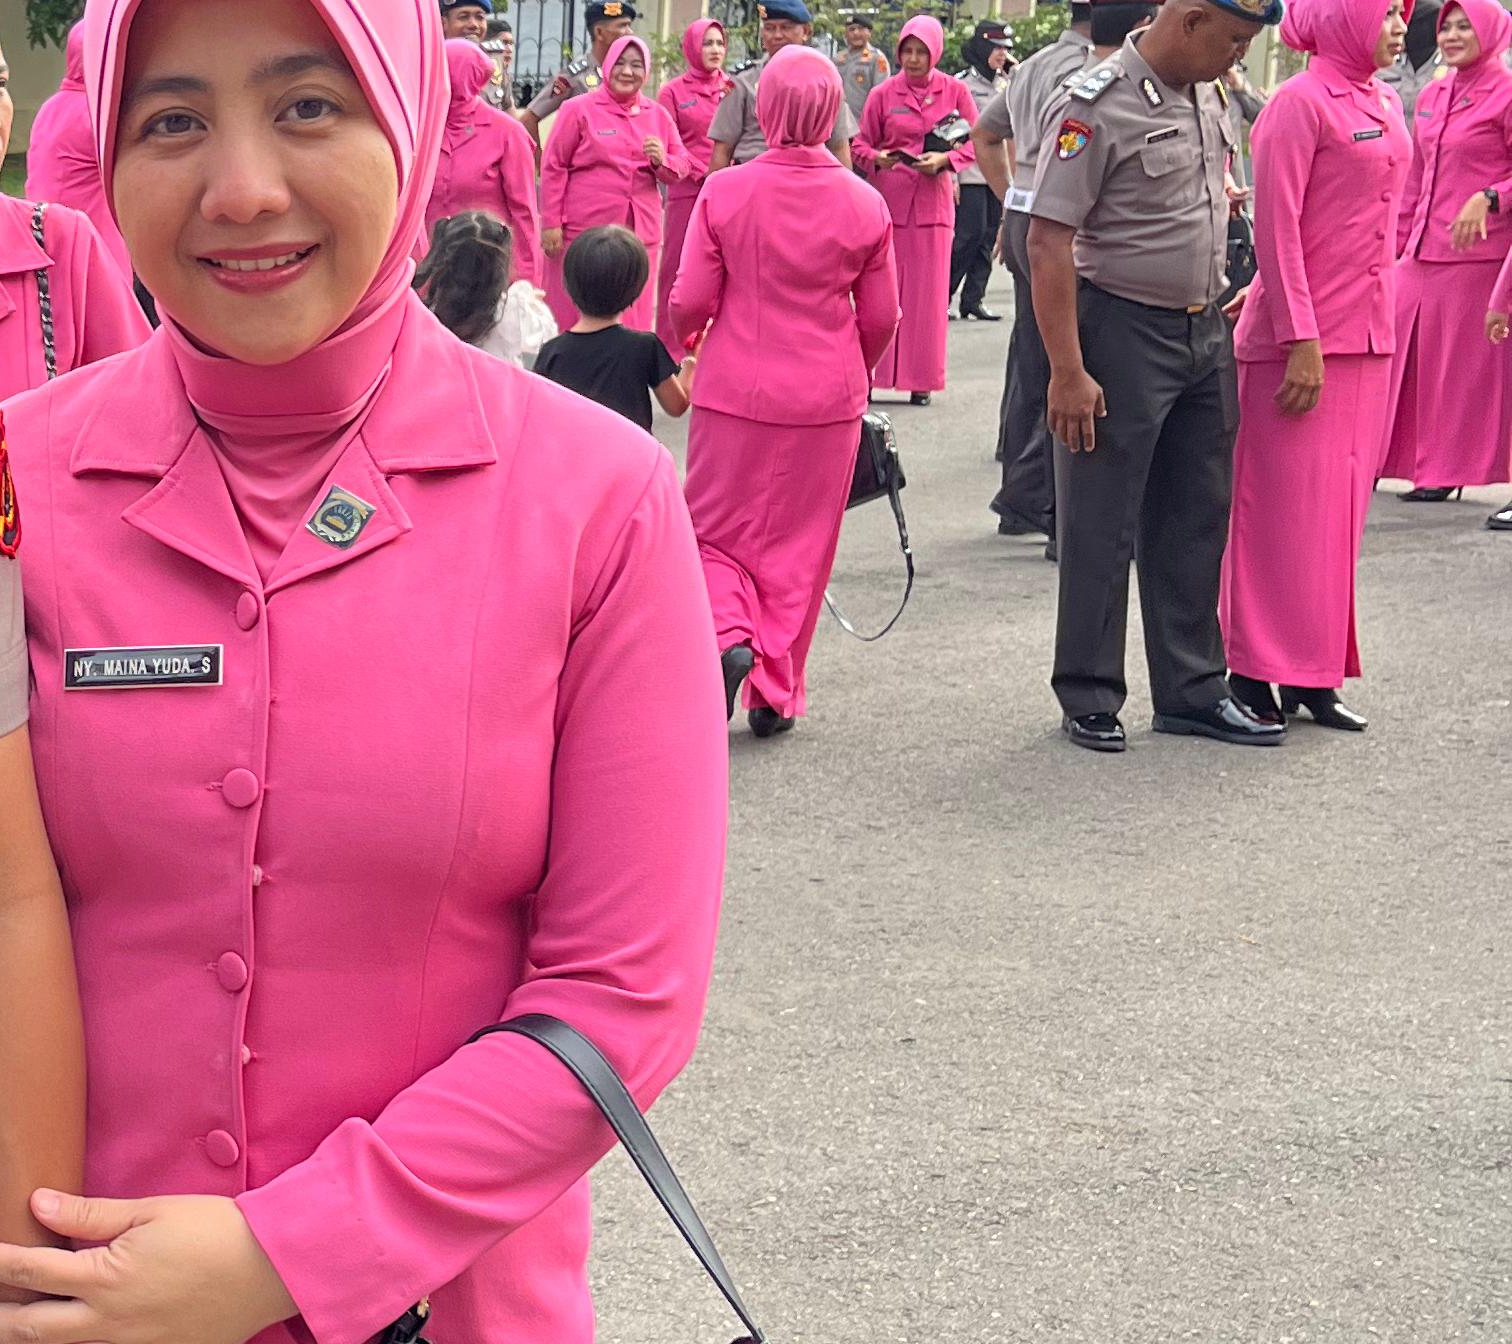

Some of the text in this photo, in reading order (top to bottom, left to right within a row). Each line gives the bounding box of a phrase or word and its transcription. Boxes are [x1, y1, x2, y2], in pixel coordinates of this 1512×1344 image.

[74, 660, 97, 677] NY.
[104, 658, 148, 676] MAINA
[202, 656, 211, 674] S
